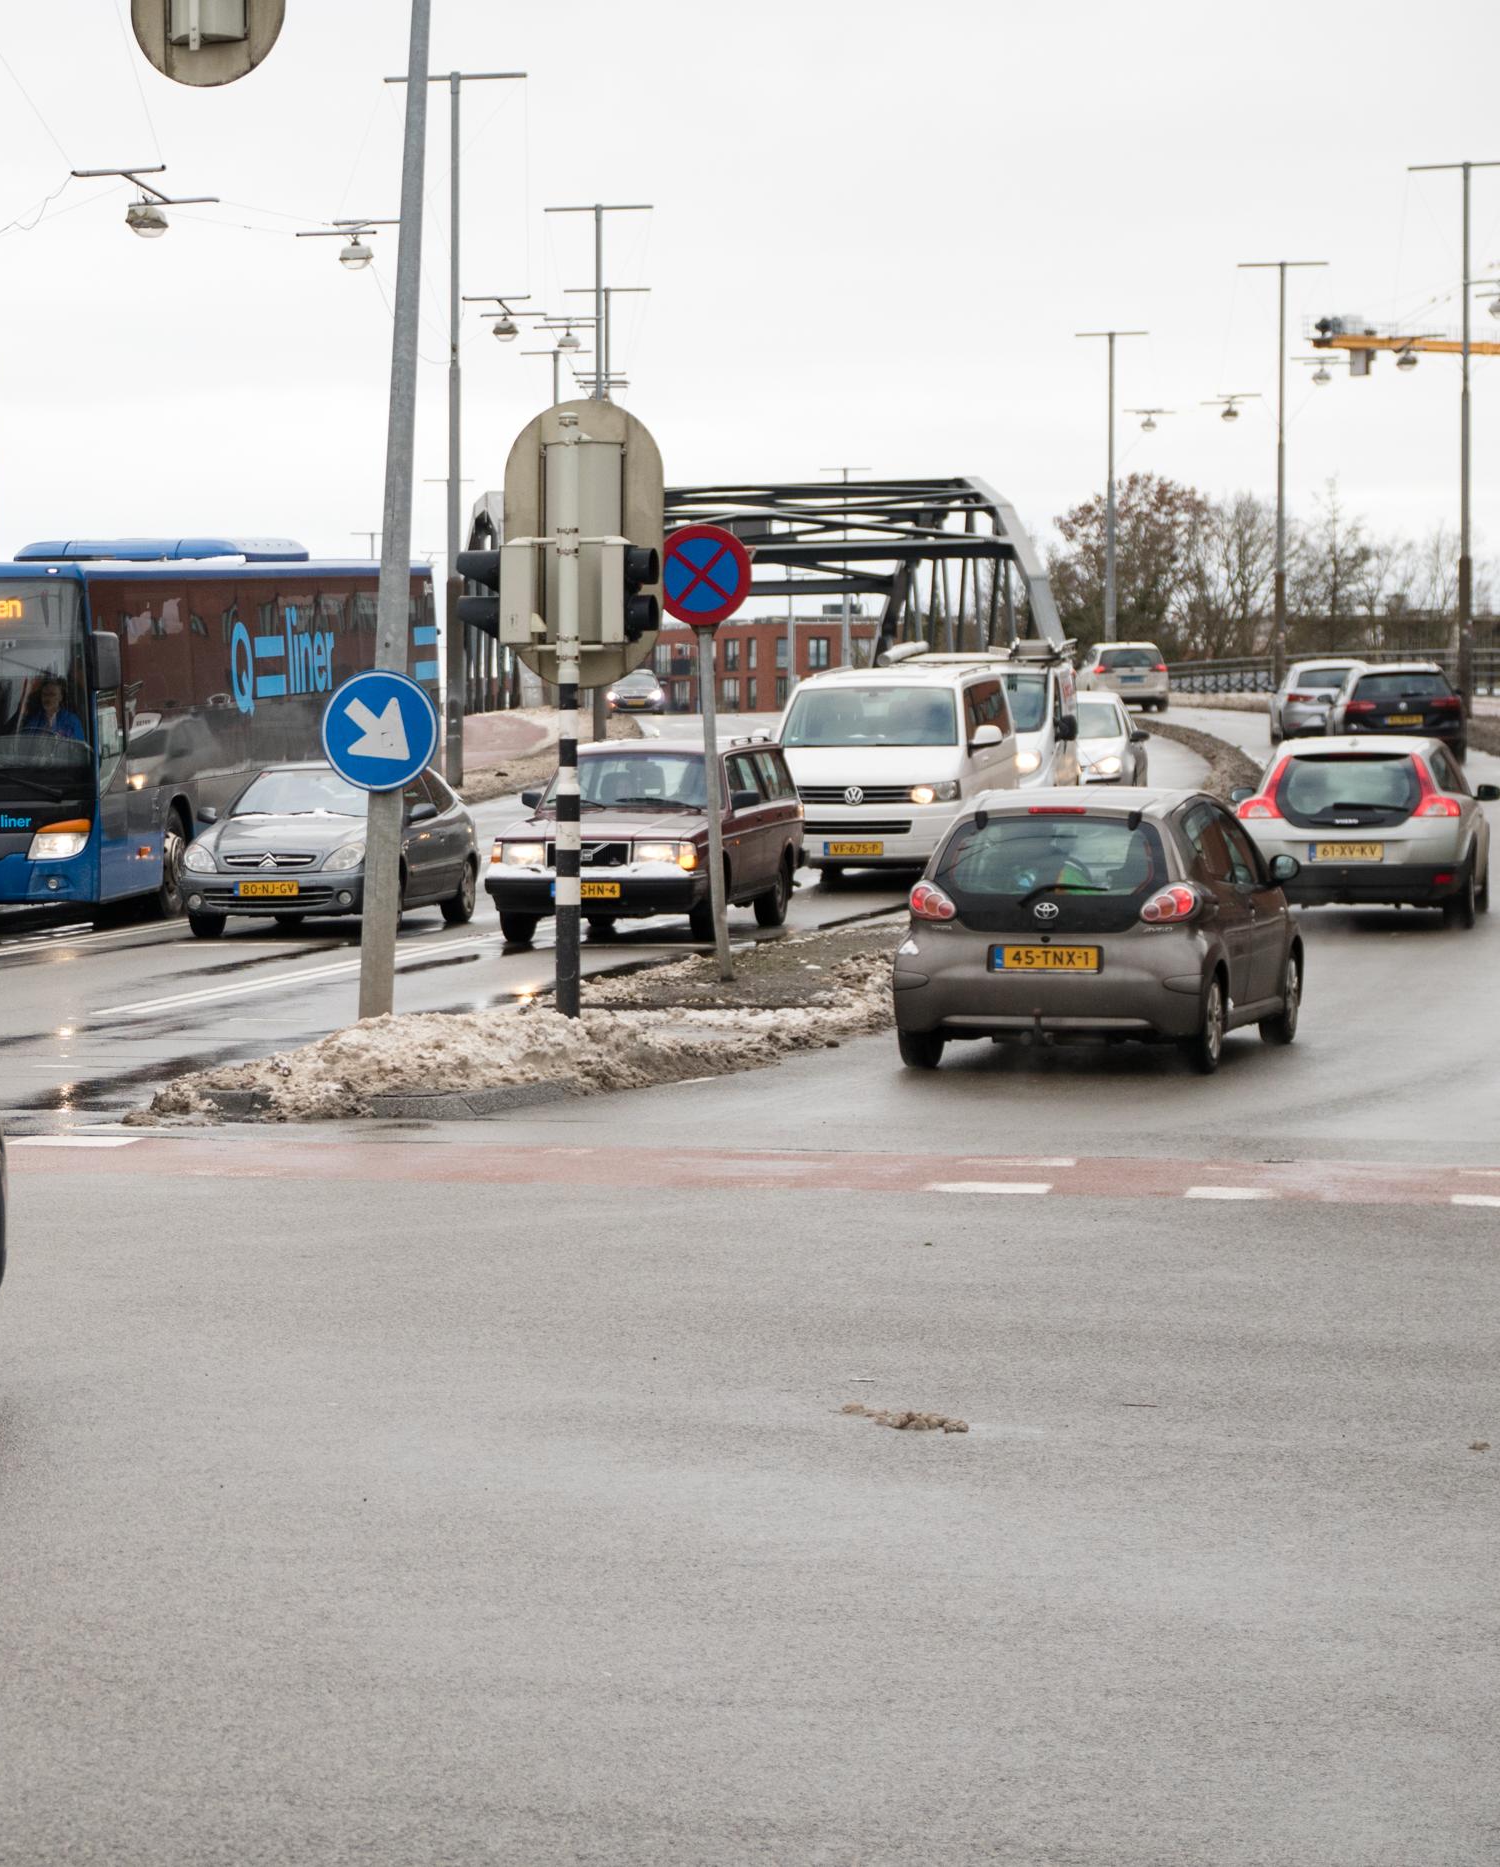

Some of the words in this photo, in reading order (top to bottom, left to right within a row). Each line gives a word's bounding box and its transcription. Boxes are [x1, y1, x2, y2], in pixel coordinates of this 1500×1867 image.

[1322, 846, 1378, 857] 61-XV-KV
[243, 884, 295, 895] 80-NJ-GV
[580, 884, 616, 896] SHN-4
[1011, 949, 1090, 967] 45-TNX-1
